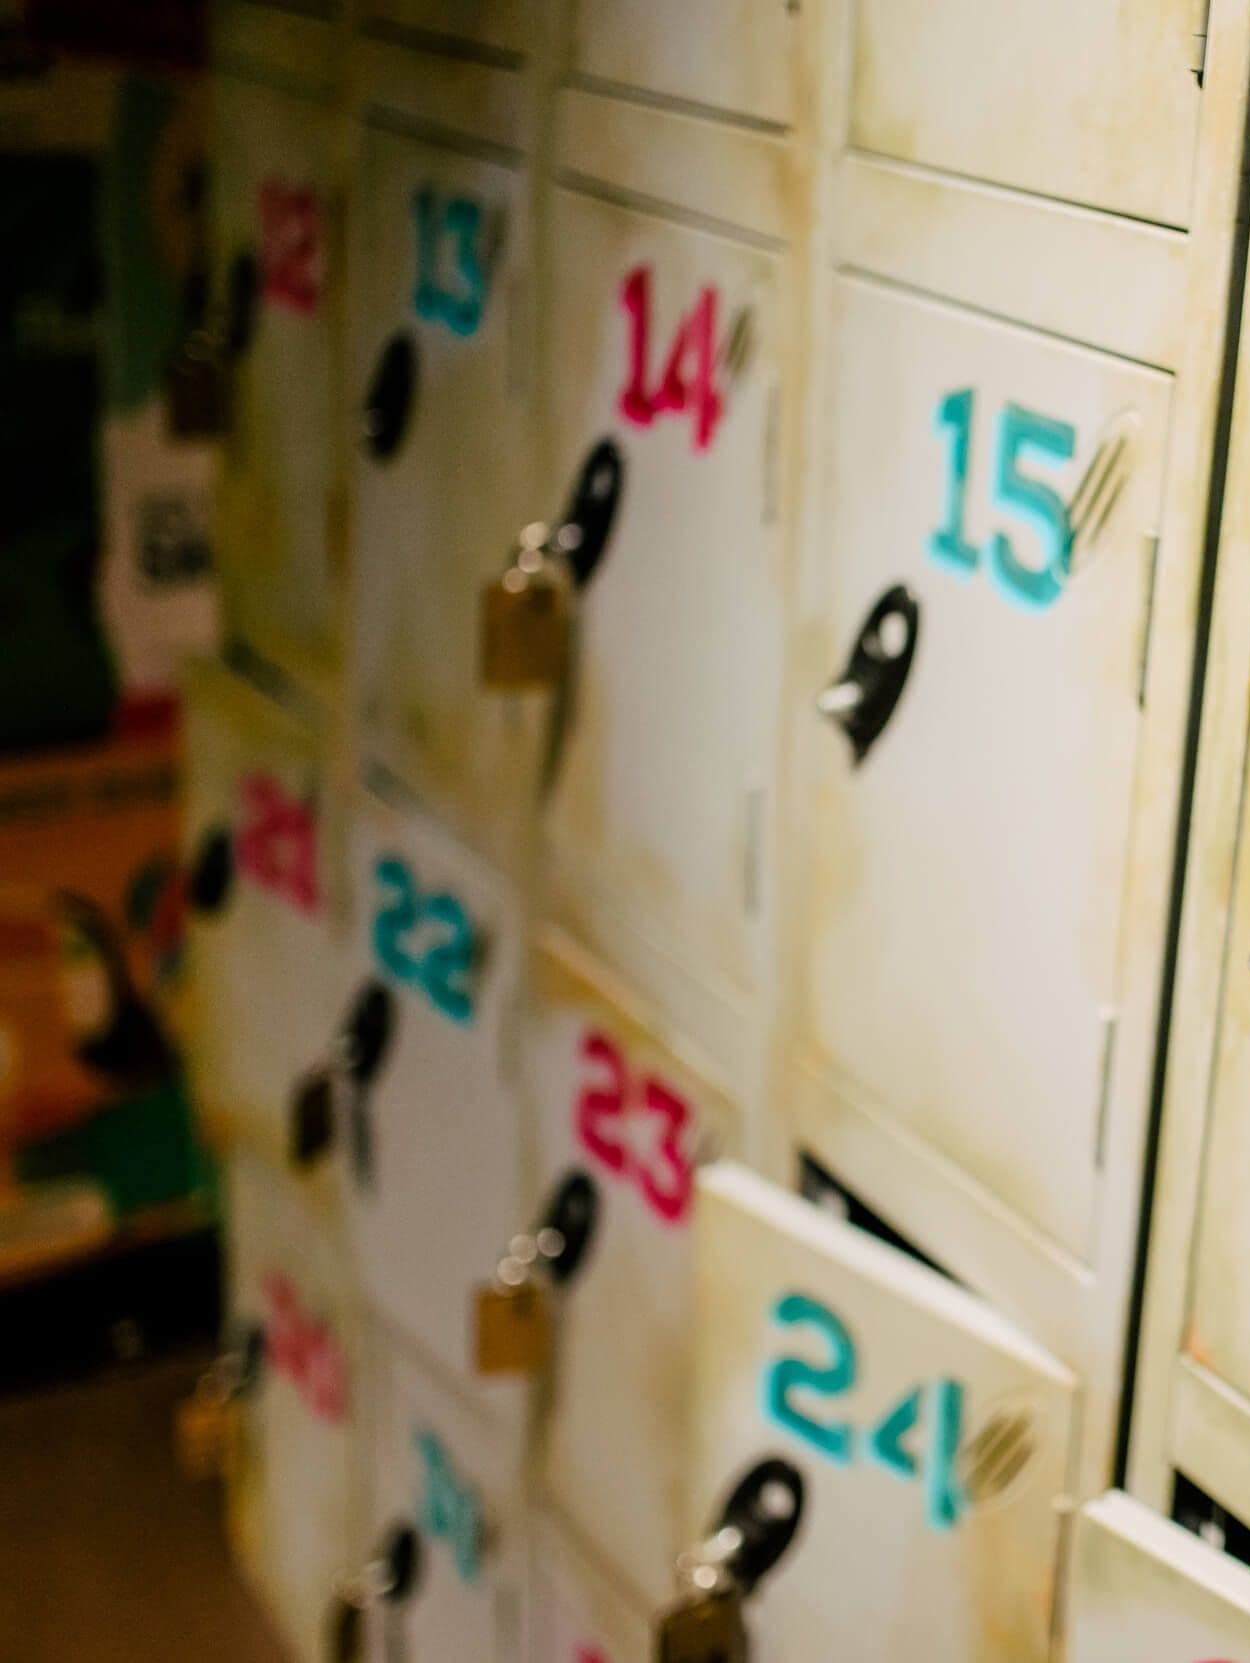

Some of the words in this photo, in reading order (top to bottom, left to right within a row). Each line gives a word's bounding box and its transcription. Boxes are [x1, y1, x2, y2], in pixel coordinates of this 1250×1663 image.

[413, 184, 485, 337] 13
[616, 264, 725, 456] 14
[924, 387, 1077, 614] 15
[372, 857, 472, 1026] 22
[571, 1031, 695, 1231] 23
[762, 1294, 969, 1529] 24
